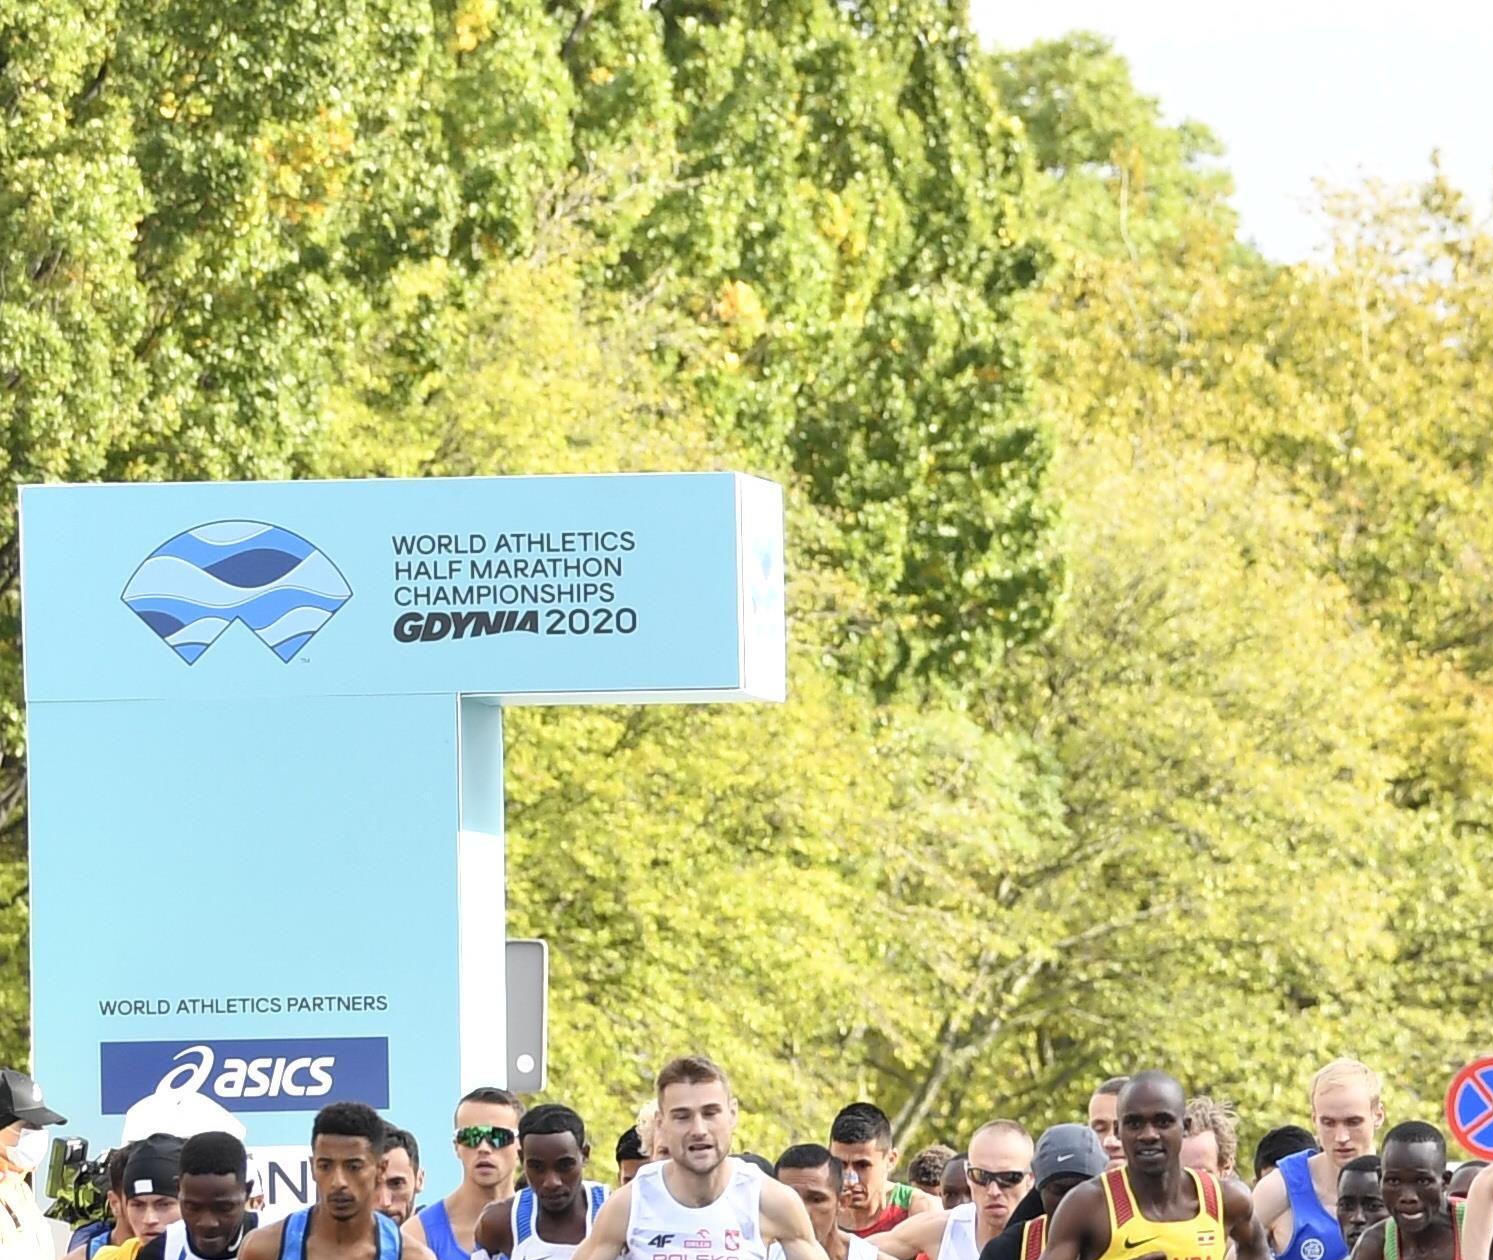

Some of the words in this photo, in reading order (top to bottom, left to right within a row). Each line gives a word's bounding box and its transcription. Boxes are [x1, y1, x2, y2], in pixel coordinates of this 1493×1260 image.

[391, 533, 487, 556] WORLD
[493, 530, 636, 553] ATHLETICS
[394, 559, 462, 581] HALF
[469, 556, 622, 580] MARATHON
[393, 582, 616, 607] CHAMPIONSHIPS
[393, 610, 539, 643] GDYNIA
[544, 608, 638, 635] 2020
[99, 999, 171, 1016] WORLD
[175, 997, 282, 1014] ATHLETICS
[287, 995, 389, 1012] PARTNERS
[213, 1056, 336, 1098] asics
